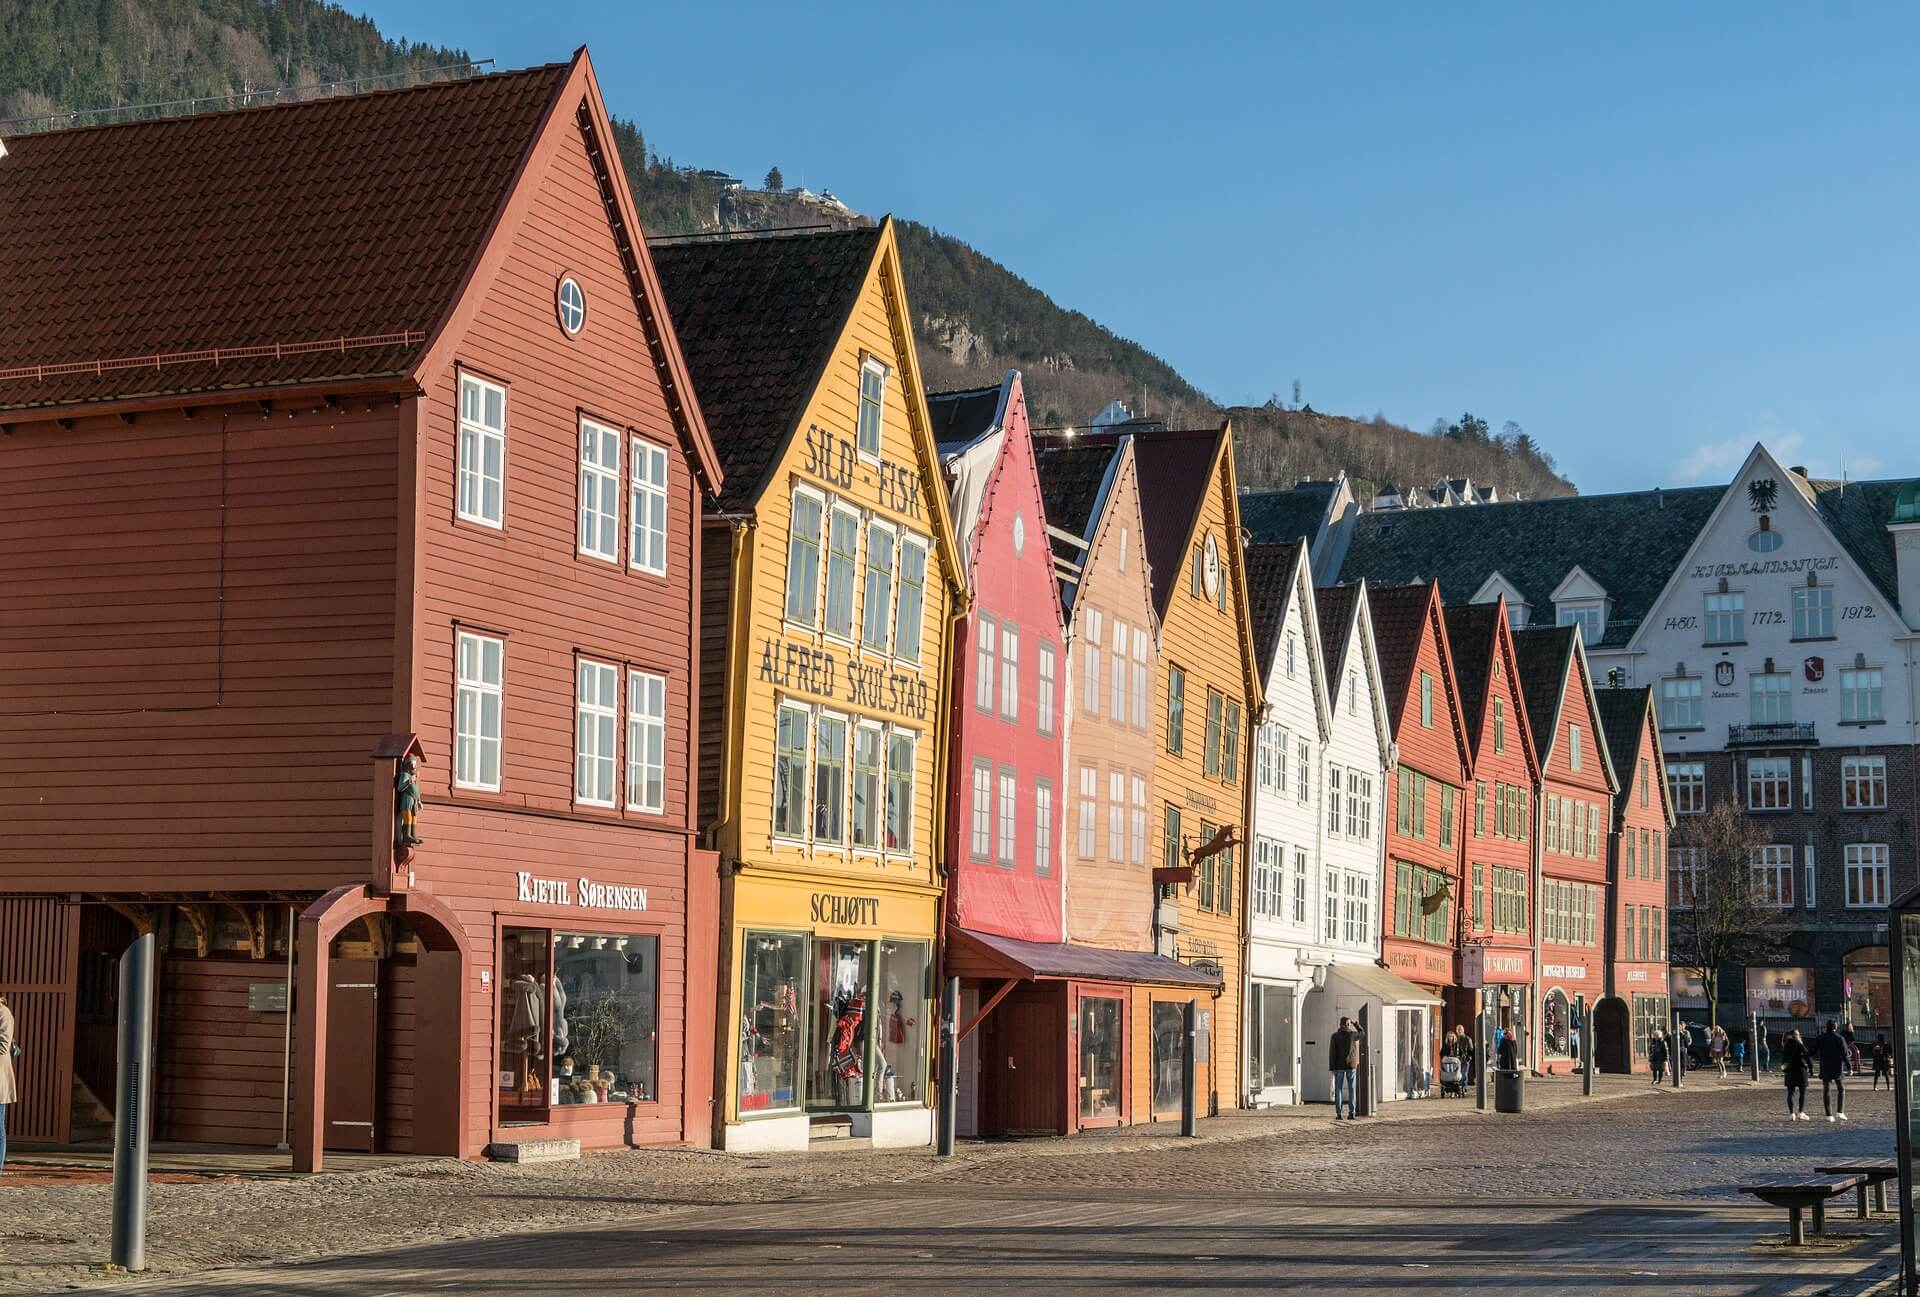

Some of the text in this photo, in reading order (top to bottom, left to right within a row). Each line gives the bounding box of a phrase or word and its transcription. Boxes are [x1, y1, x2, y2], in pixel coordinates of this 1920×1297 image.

[804, 423, 853, 490] SILD
[879, 459, 922, 521] FISK
[759, 635, 928, 720] ALFRED SKULSTAD
[811, 892, 879, 926] SCHJØTT
